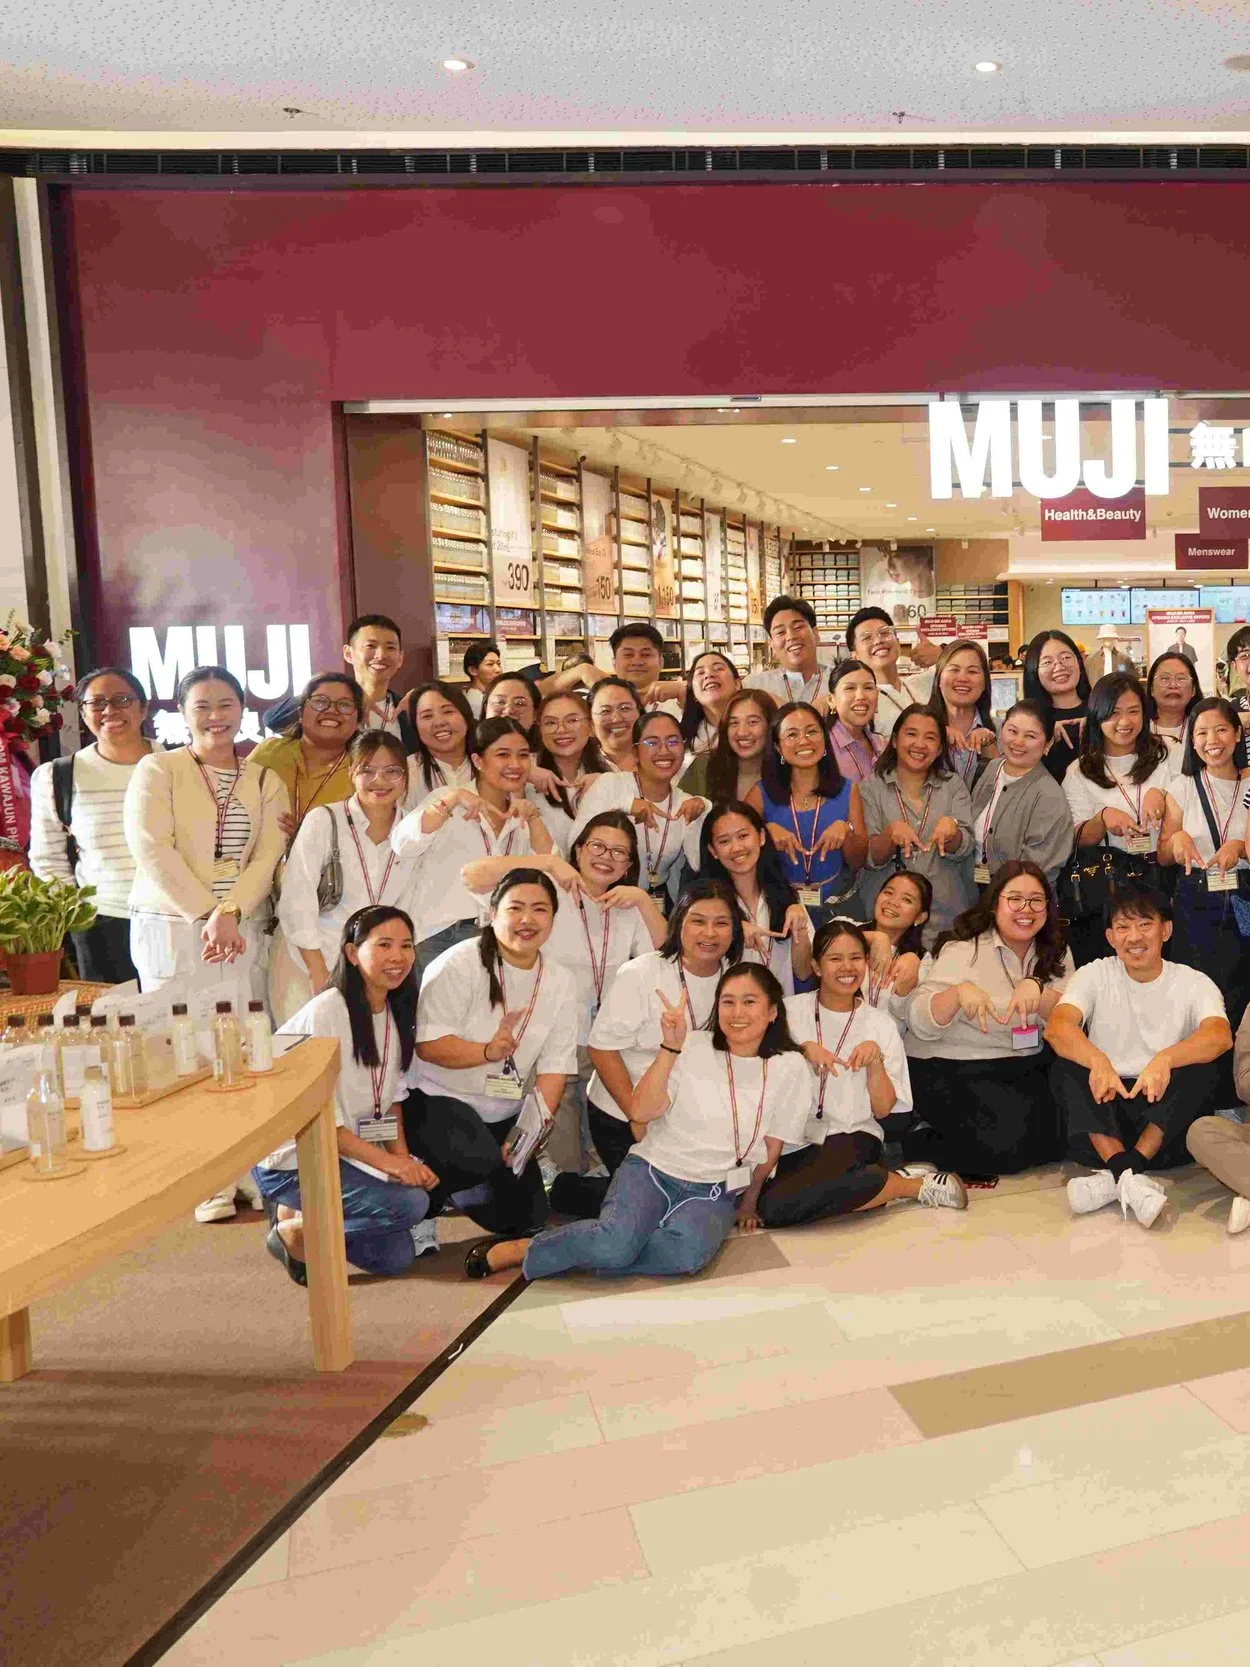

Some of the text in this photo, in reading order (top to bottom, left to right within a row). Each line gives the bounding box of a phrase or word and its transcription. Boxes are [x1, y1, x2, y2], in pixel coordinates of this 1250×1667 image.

[929, 398, 1170, 499] MUJI
[1044, 507, 1142, 522] Health&Beauty
[1188, 547, 1235, 557] Menswear
[507, 562, 530, 592] 390
[0, 766, 18, 825] KAWAJUN
